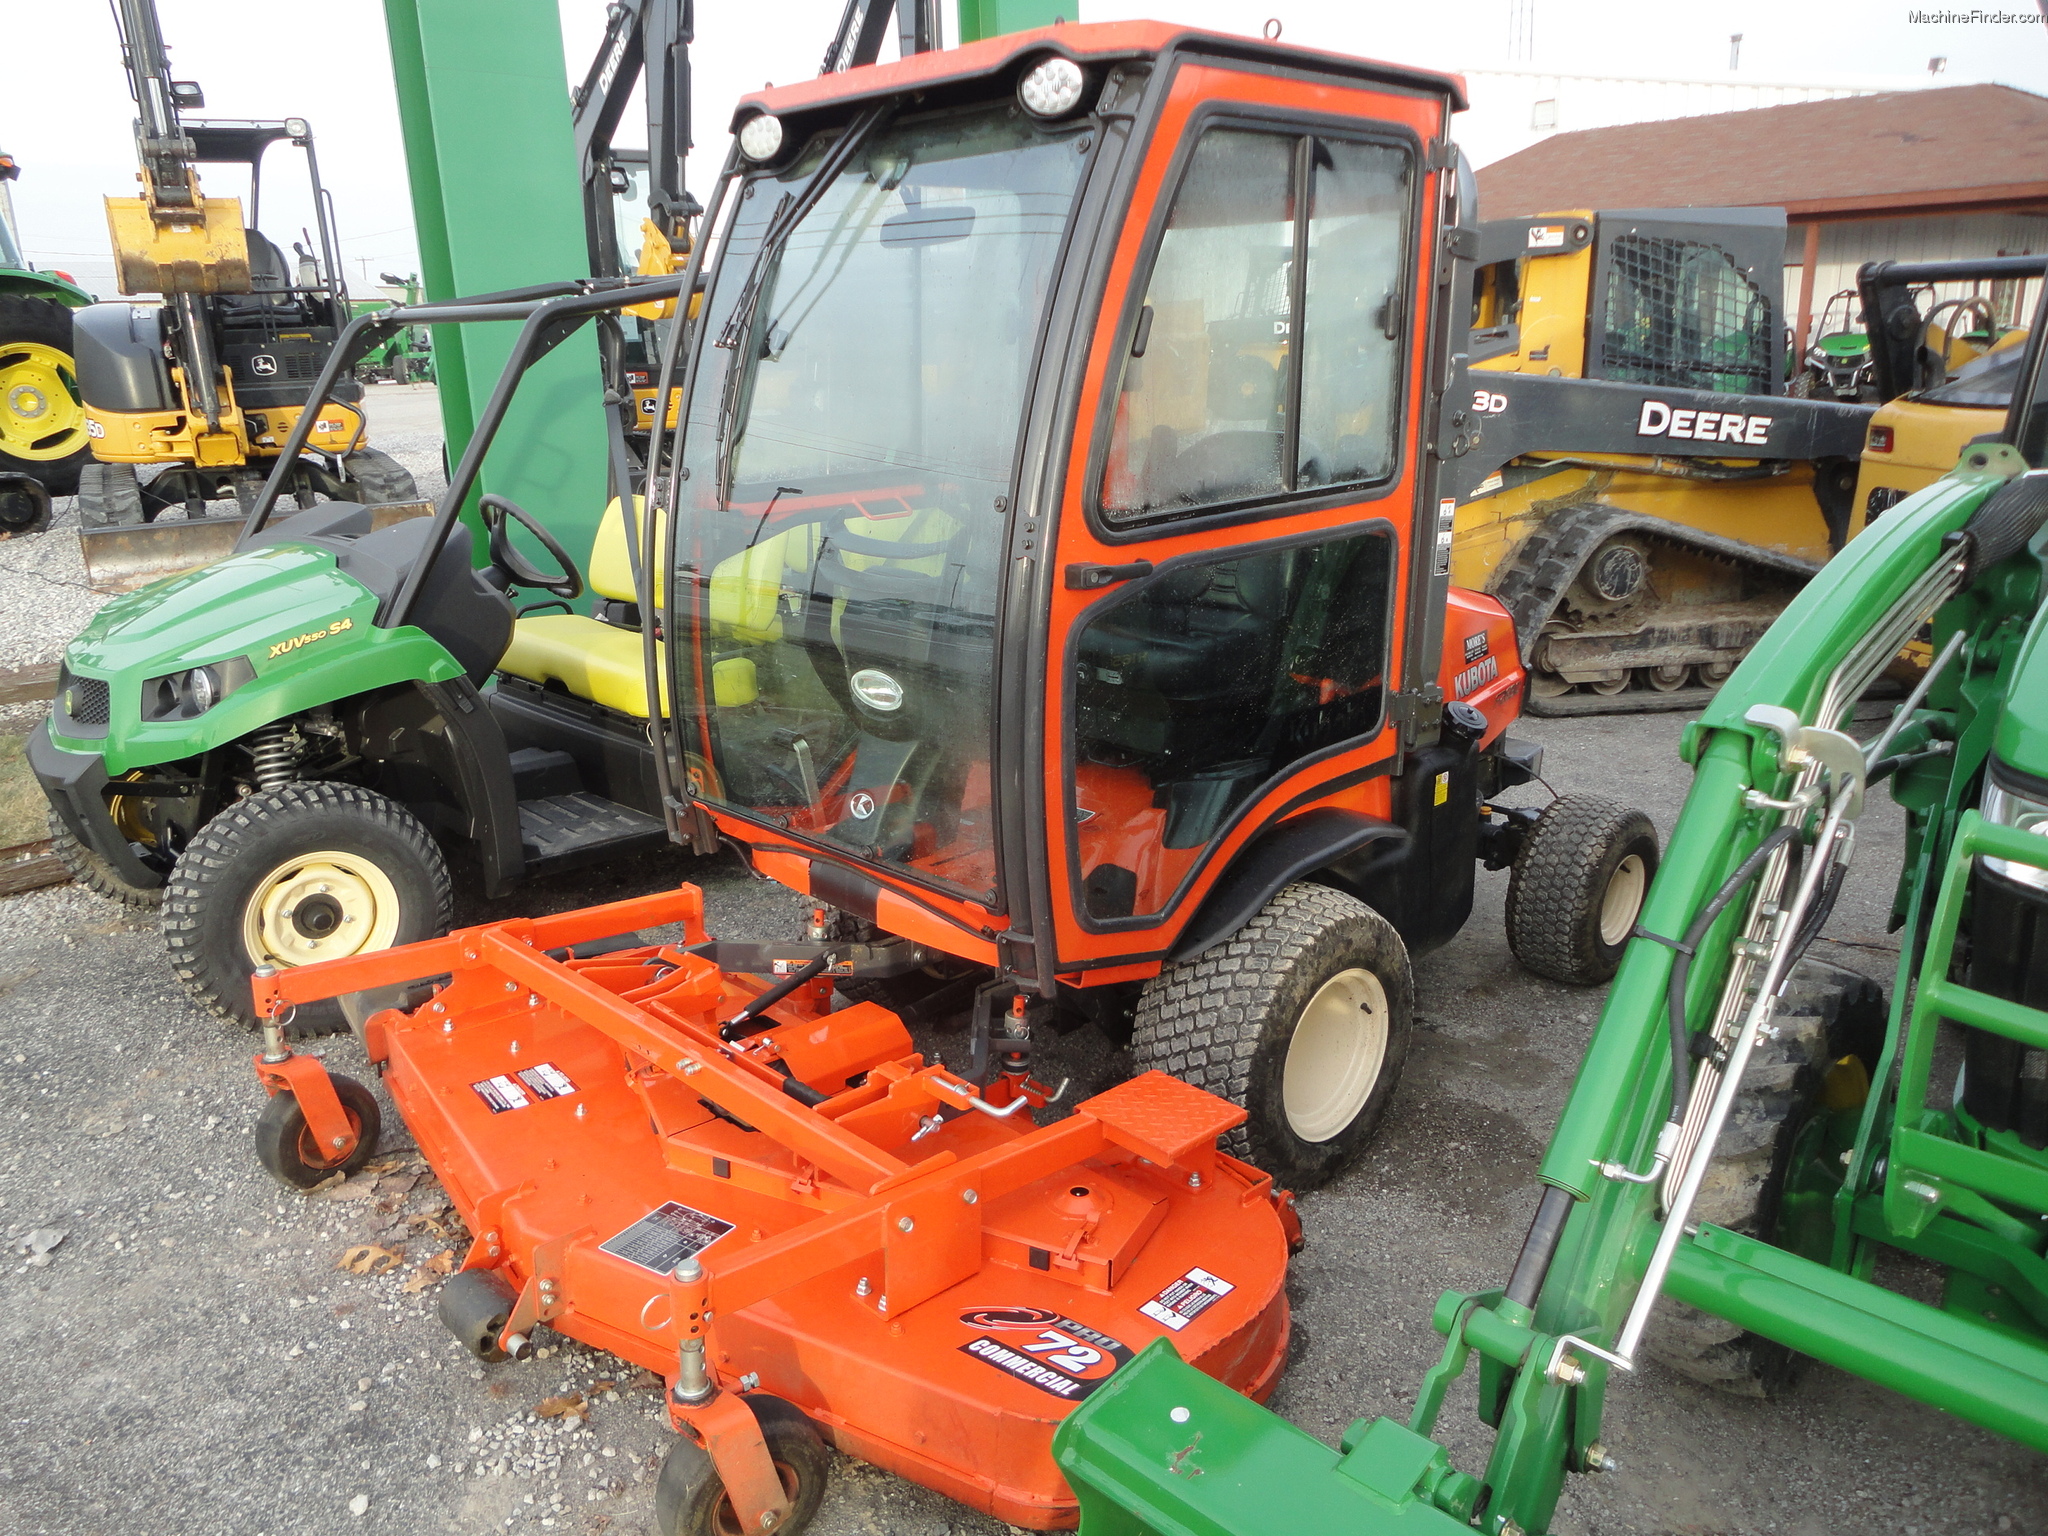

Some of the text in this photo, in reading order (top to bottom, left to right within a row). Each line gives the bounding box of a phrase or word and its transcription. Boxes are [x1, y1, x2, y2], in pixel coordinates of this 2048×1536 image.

[837, 5, 864, 73] DEERE
[599, 29, 627, 96] DEERE
[1637, 400, 1772, 445] DEERE
[268, 618, 353, 660] XUV550 S4
[1454, 655, 1498, 700] KUBOTA
[1020, 1330, 1102, 1374] 72
[1054, 1318, 1123, 1351] PRO
[968, 1339, 1082, 1396] COMMERCIAL
